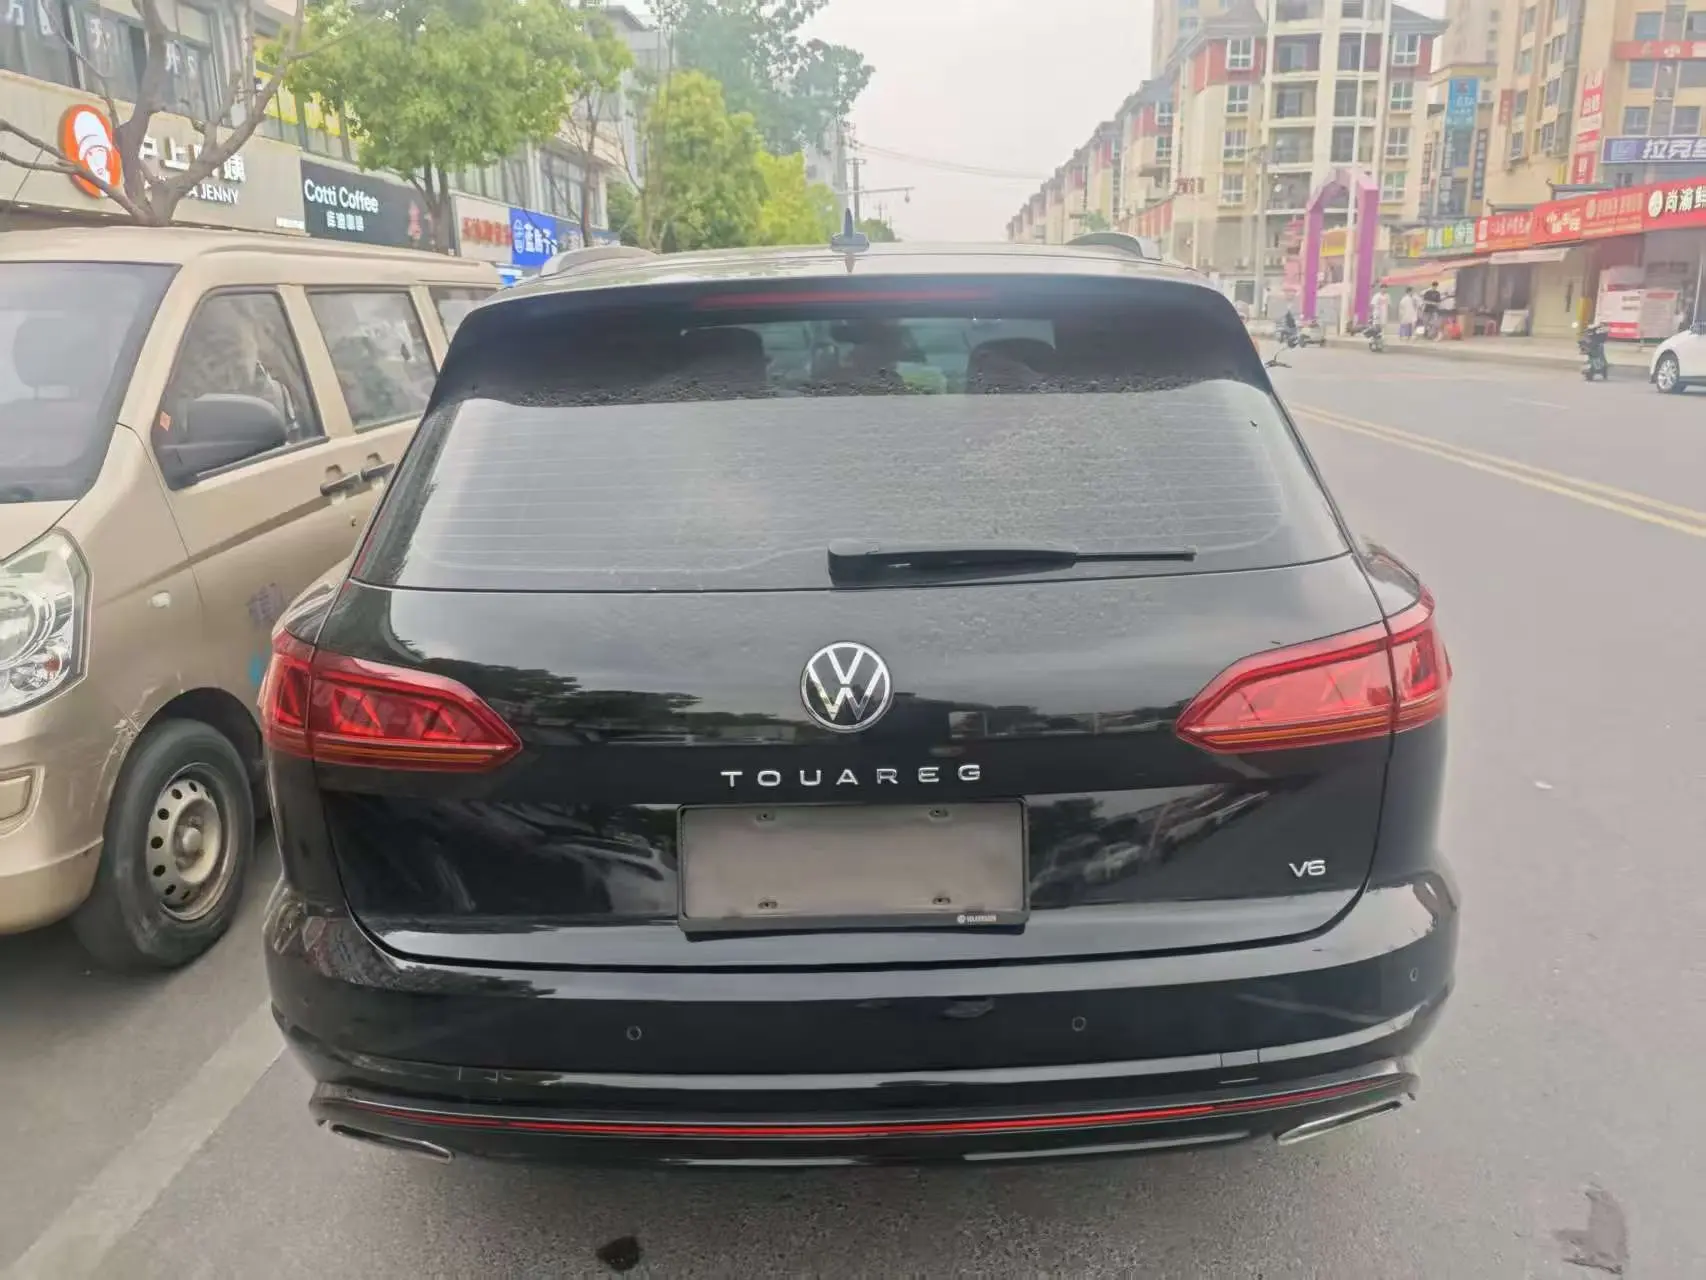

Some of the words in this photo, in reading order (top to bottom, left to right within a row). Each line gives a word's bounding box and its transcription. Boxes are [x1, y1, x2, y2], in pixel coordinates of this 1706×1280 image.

[138, 135, 246, 182] 沪上姨
[200, 182, 240, 206] JENNY
[304, 179, 338, 206] Cotti
[338, 186, 379, 213] Coffee
[720, 764, 982, 788] TOUAREG
[1289, 859, 1326, 878] V6
